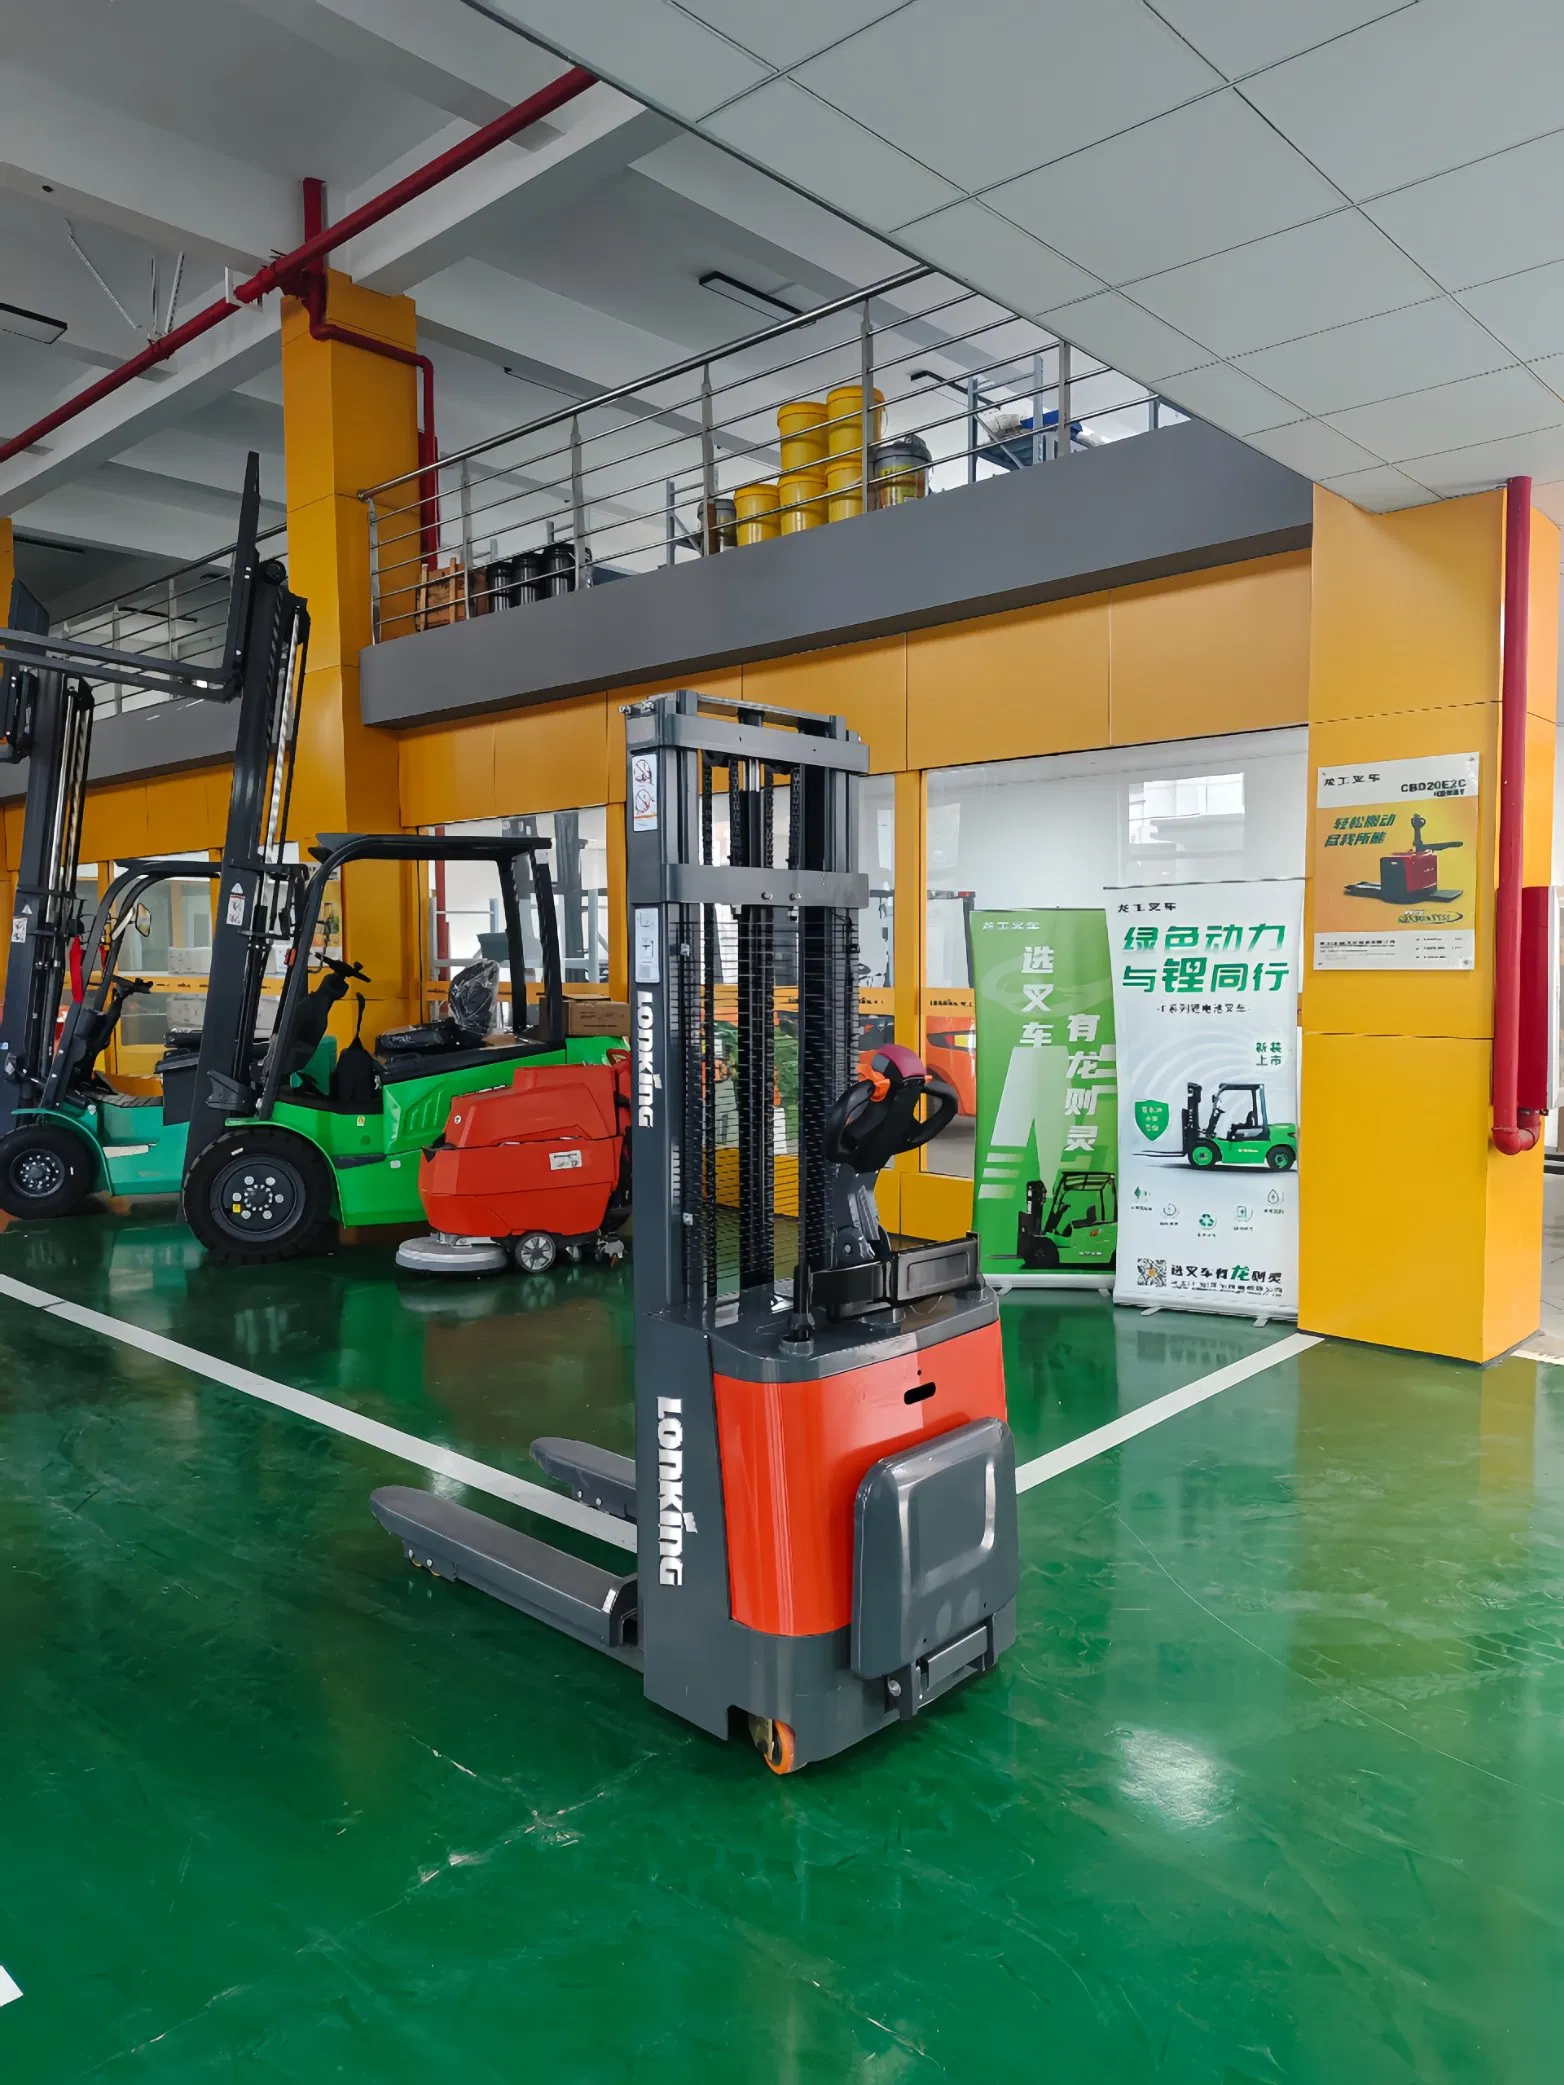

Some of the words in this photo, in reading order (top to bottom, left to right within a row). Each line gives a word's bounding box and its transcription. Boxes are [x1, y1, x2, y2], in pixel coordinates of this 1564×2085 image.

[1401, 778, 1467, 792] CBD20E2C
[1123, 923, 1286, 954] 绿色动力
[1122, 957, 1289, 993] 与锂同行
[1020, 946, 1054, 1048] 选叉车
[1256, 1055, 1282, 1066] 上市
[1064, 1013, 1101, 1151] 有龙则灵
